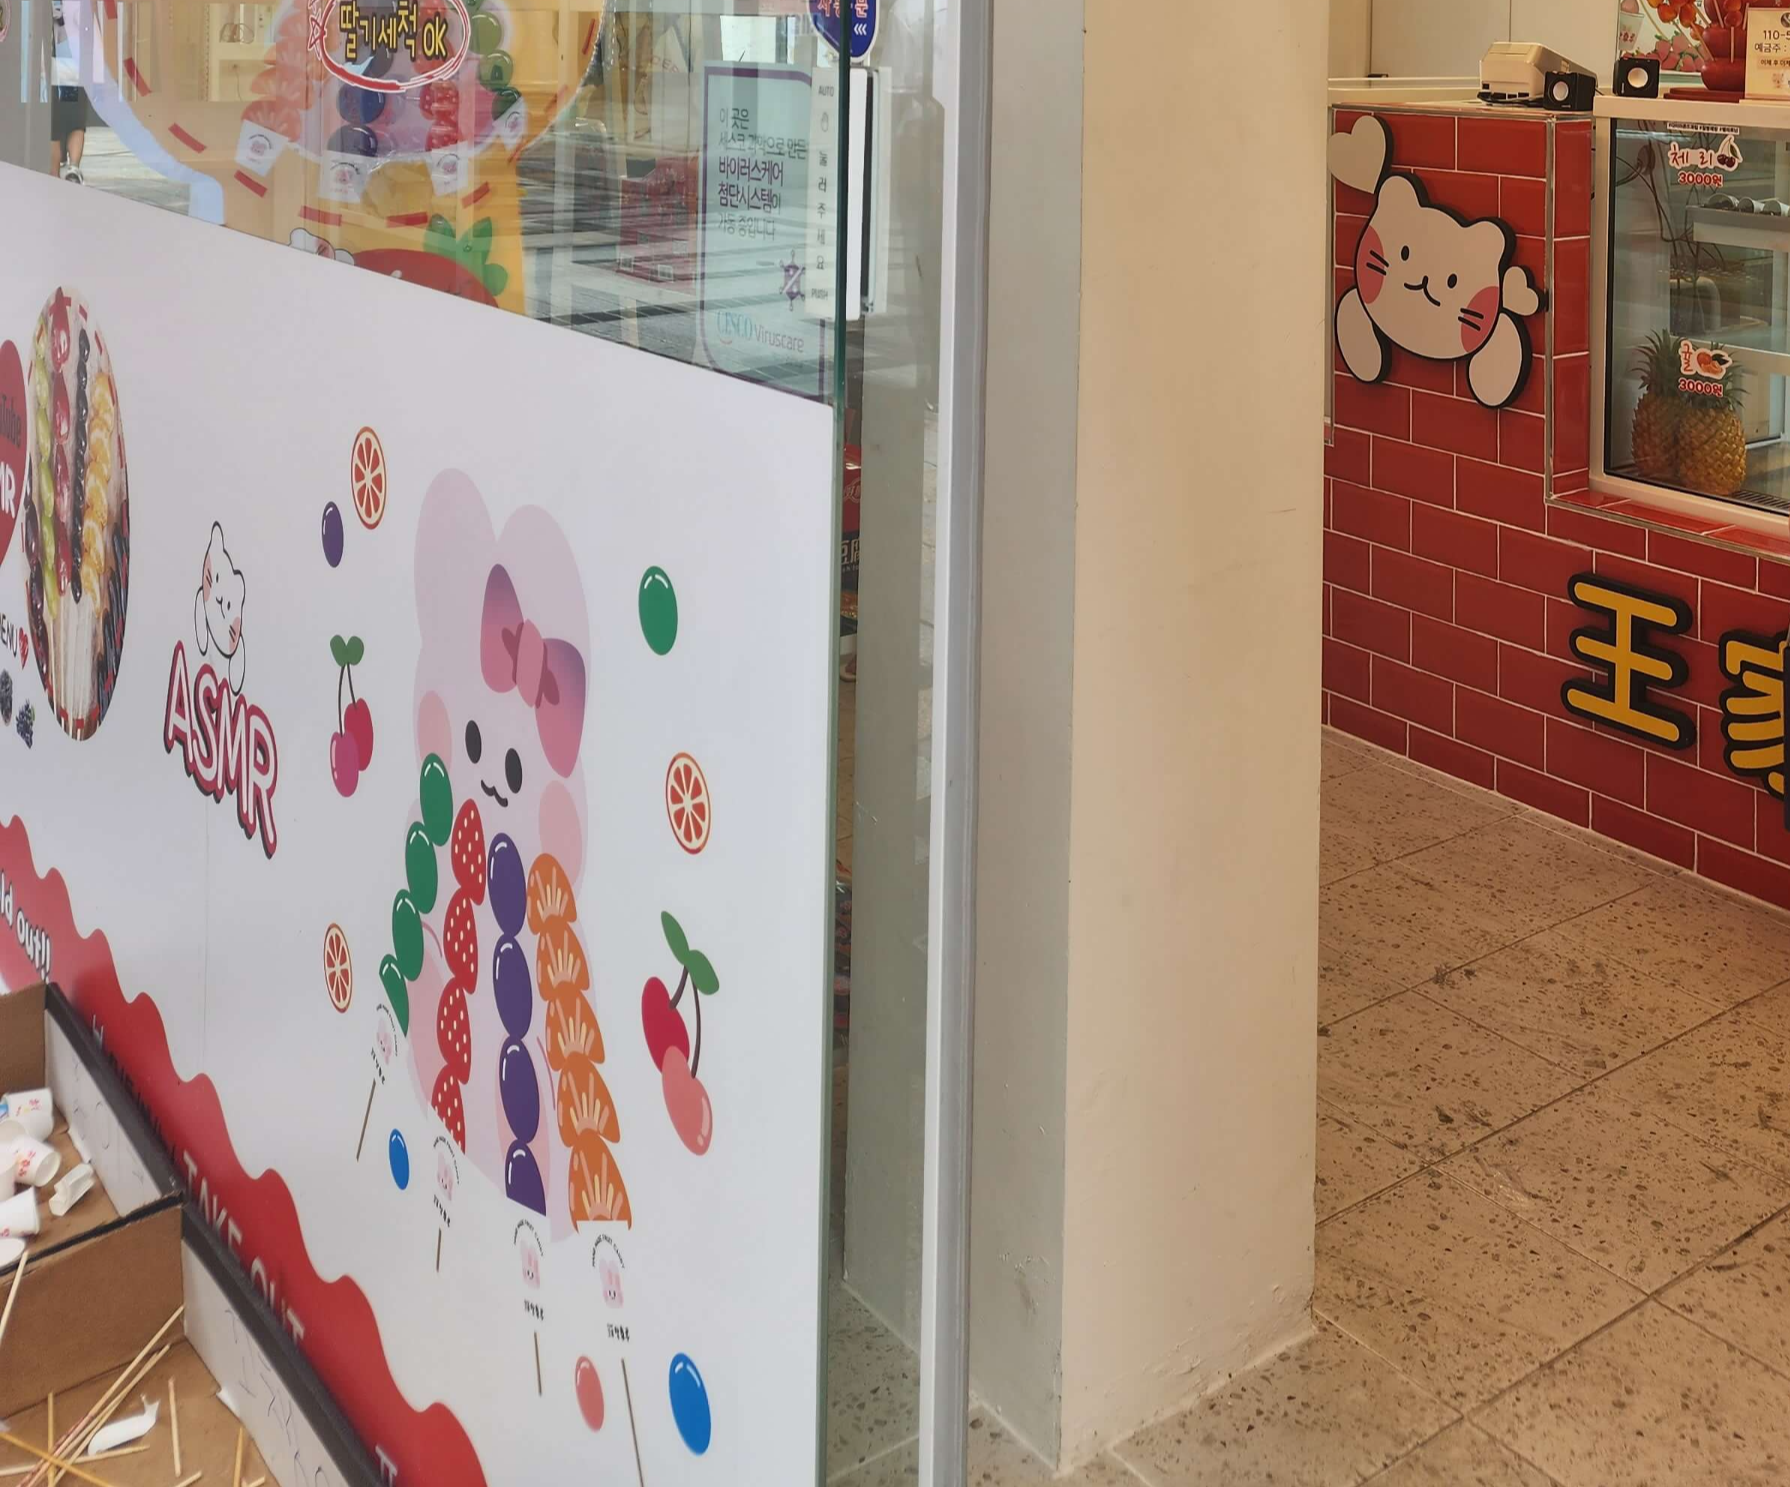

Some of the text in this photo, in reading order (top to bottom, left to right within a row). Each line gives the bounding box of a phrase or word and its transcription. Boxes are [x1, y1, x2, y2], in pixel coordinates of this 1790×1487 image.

[1754, 43, 1781, 53] 예금주
[818, 85, 834, 97] AUTO
[719, 107, 750, 130] 이 곳은
[719, 131, 746, 152] 세스코
[718, 155, 784, 187] 바이러스케어
[1679, 172, 1722, 187] 3000원
[718, 181, 781, 215] 첨단시스템이
[717, 213, 777, 241] 가동 중입니다
[754, 324, 805, 354] Viruscare
[1679, 378, 1723, 397] 3000원
[164, 640, 278, 859] ASMR
